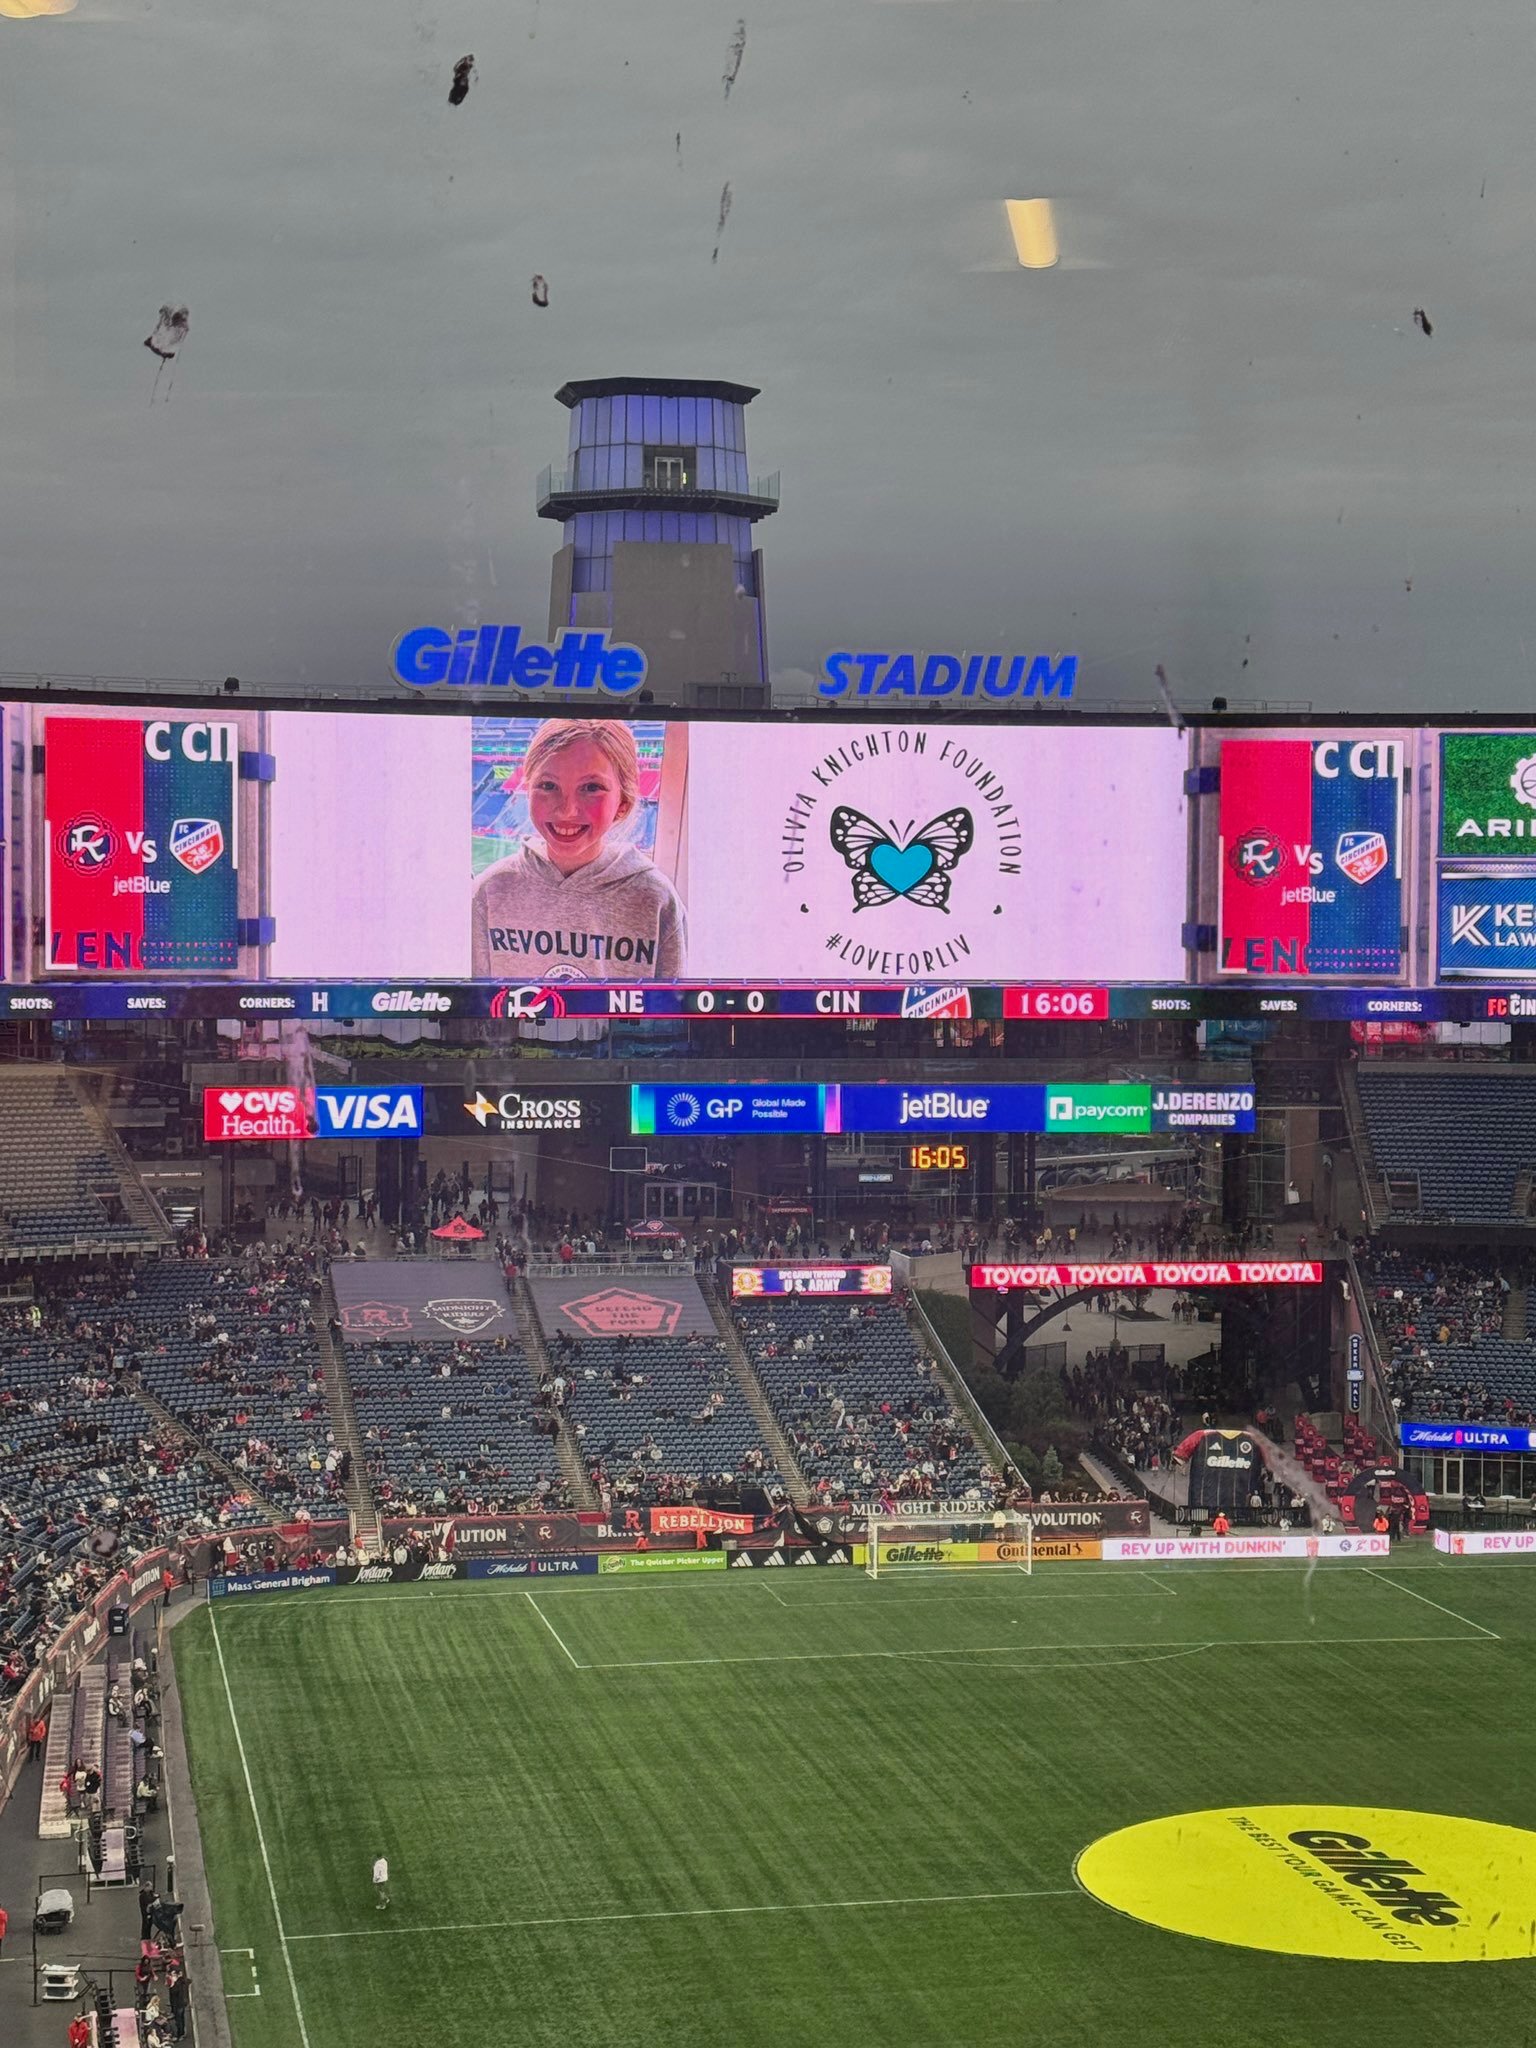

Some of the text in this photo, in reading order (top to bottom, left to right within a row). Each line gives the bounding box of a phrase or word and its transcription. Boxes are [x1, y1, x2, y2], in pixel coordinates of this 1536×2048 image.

[395, 625, 644, 691] Gillette
[818, 652, 1078, 698] STADIUM
[782, 730, 1022, 875] OLIVIA KNIGHTON FOUNDATION
[174, 824, 218, 854] CINCINNATI
[1340, 837, 1382, 864] CINCINNATI
[112, 875, 171, 897] jetBlue
[1280, 886, 1336, 906] jetBlue
[1495, 904, 1536, 927] KE
[489, 927, 656, 965] REVOLUTION
[825, 933, 971, 976] #LOVEFORLIV
[10, 997, 53, 1010] SHOTS:
[127, 998, 166, 1009] SAVES:
[239, 997, 295, 1009] CORNERS:
[372, 991, 451, 1012] Gillette
[608, 991, 644, 1013] NE
[697, 991, 714, 1012] 0
[747, 991, 765, 1012] 0
[816, 991, 860, 1013] CIN
[1021, 993, 1094, 1015] 16:06
[1151, 1000, 1191, 1011] SHOTS:
[1260, 1000, 1297, 1011] SAVES:
[1368, 1001, 1422, 1012] CORNERS:
[1487, 998, 1508, 1017] FC
[244, 1091, 295, 1113] CVS
[752, 1098, 806, 1108] Global Made
[900, 1092, 990, 1124] jetBlue
[1075, 1103, 1145, 1119] paycom
[1152, 1092, 1253, 1111] J.DERENZO
[318, 1094, 417, 1129] VISA
[752, 1109, 788, 1119] Possible
[1168, 1114, 1236, 1126] COMPANIES
[501, 1119, 581, 1129] INSURANCE
[912, 1146, 965, 1168] 16:05
[981, 1263, 1315, 1285] TOYOTA TOYOTA TOYOTA TOYOTA
[808, 1278, 841, 1292] ARMY
[1464, 1432, 1509, 1445] ULTRA
[1206, 1456, 1252, 1469] Gillette
[1121, 1540, 1286, 1555] REV UP WITH DUNKIN'
[1483, 1536, 1534, 1549] REV UP
[630, 1555, 724, 1567] The Quicker Picker Upper
[886, 1546, 944, 1562] Gillette
[347, 1566, 393, 1584] Jordan's
[412, 1563, 457, 1581] Jordan's
[538, 1561, 579, 1572] ULTRA
[228, 1575, 330, 1592] Mass General Brigham
[1226, 1816, 1423, 1951] THE BEST YOUR GAME CAN GET
[1288, 1830, 1463, 1926] Gillette
